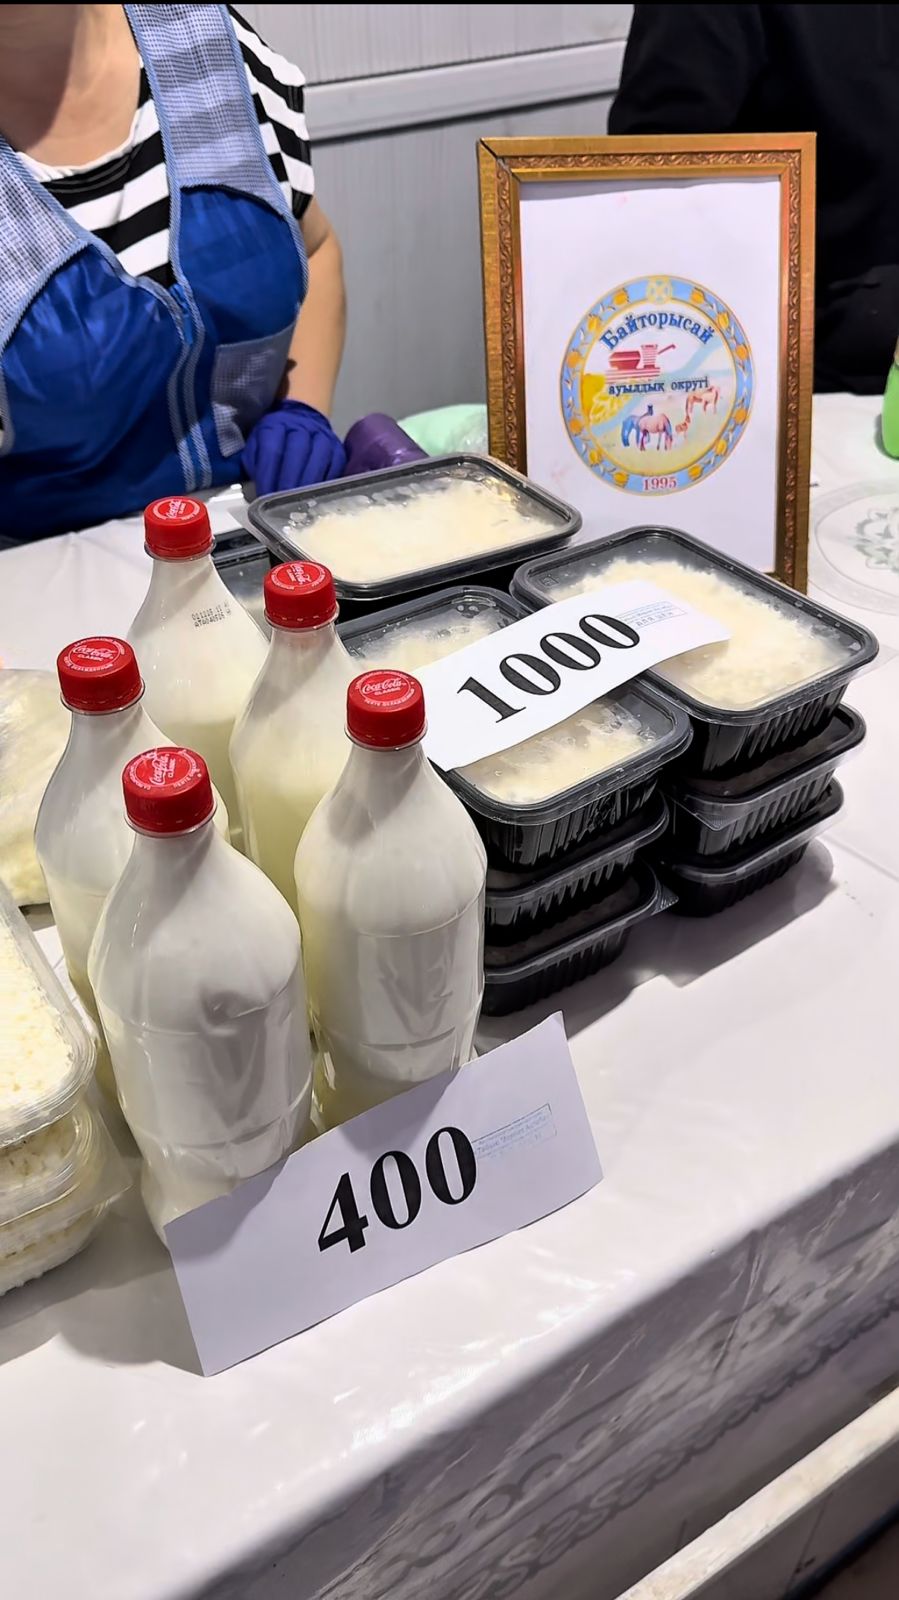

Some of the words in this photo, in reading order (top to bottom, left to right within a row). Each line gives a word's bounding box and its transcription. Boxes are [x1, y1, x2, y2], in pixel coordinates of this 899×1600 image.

[600, 312, 715, 350] Байторысай
[671, 376, 710, 392] округі
[644, 476, 677, 490] 1995
[457, 614, 640, 723] 1000
[362, 677, 407, 695] Coca-Cola
[317, 1126, 477, 1253] 400
